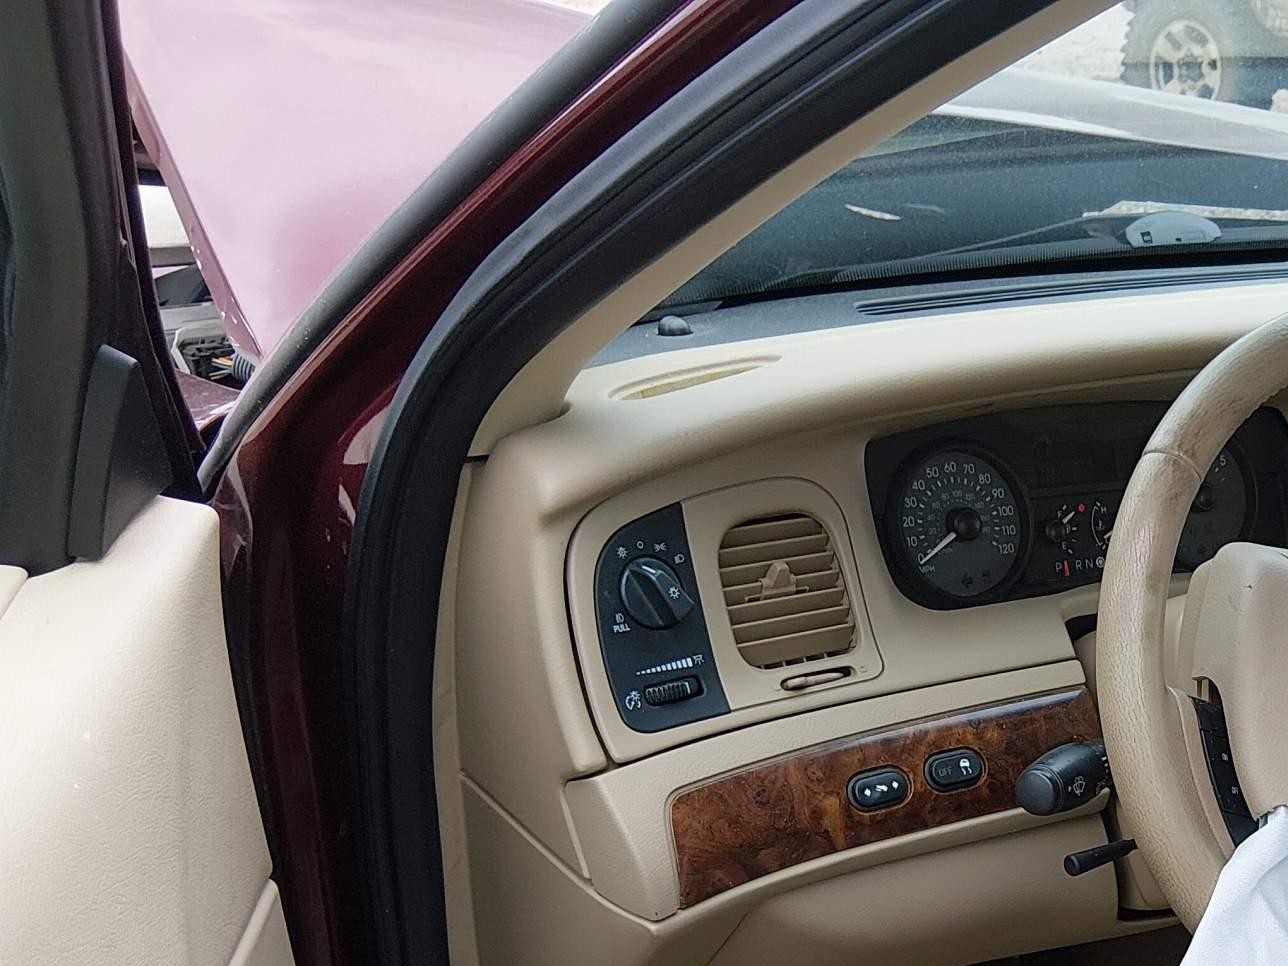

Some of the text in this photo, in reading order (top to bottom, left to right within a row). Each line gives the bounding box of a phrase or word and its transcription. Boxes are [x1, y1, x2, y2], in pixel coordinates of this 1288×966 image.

[926, 466, 939, 478] 50
[944, 462, 957, 473] 60
[963, 463, 975, 474] 70
[978, 473, 991, 484] 80
[912, 480, 925, 490] 40
[991, 488, 1005, 498] 90
[904, 497, 917, 508] 30
[998, 505, 1014, 516] 100
[902, 516, 915, 527] 20
[1001, 525, 1016, 535] 110
[907, 536, 918, 547] 10
[998, 543, 1015, 554] 120
[613, 623, 631, 633] PULL
